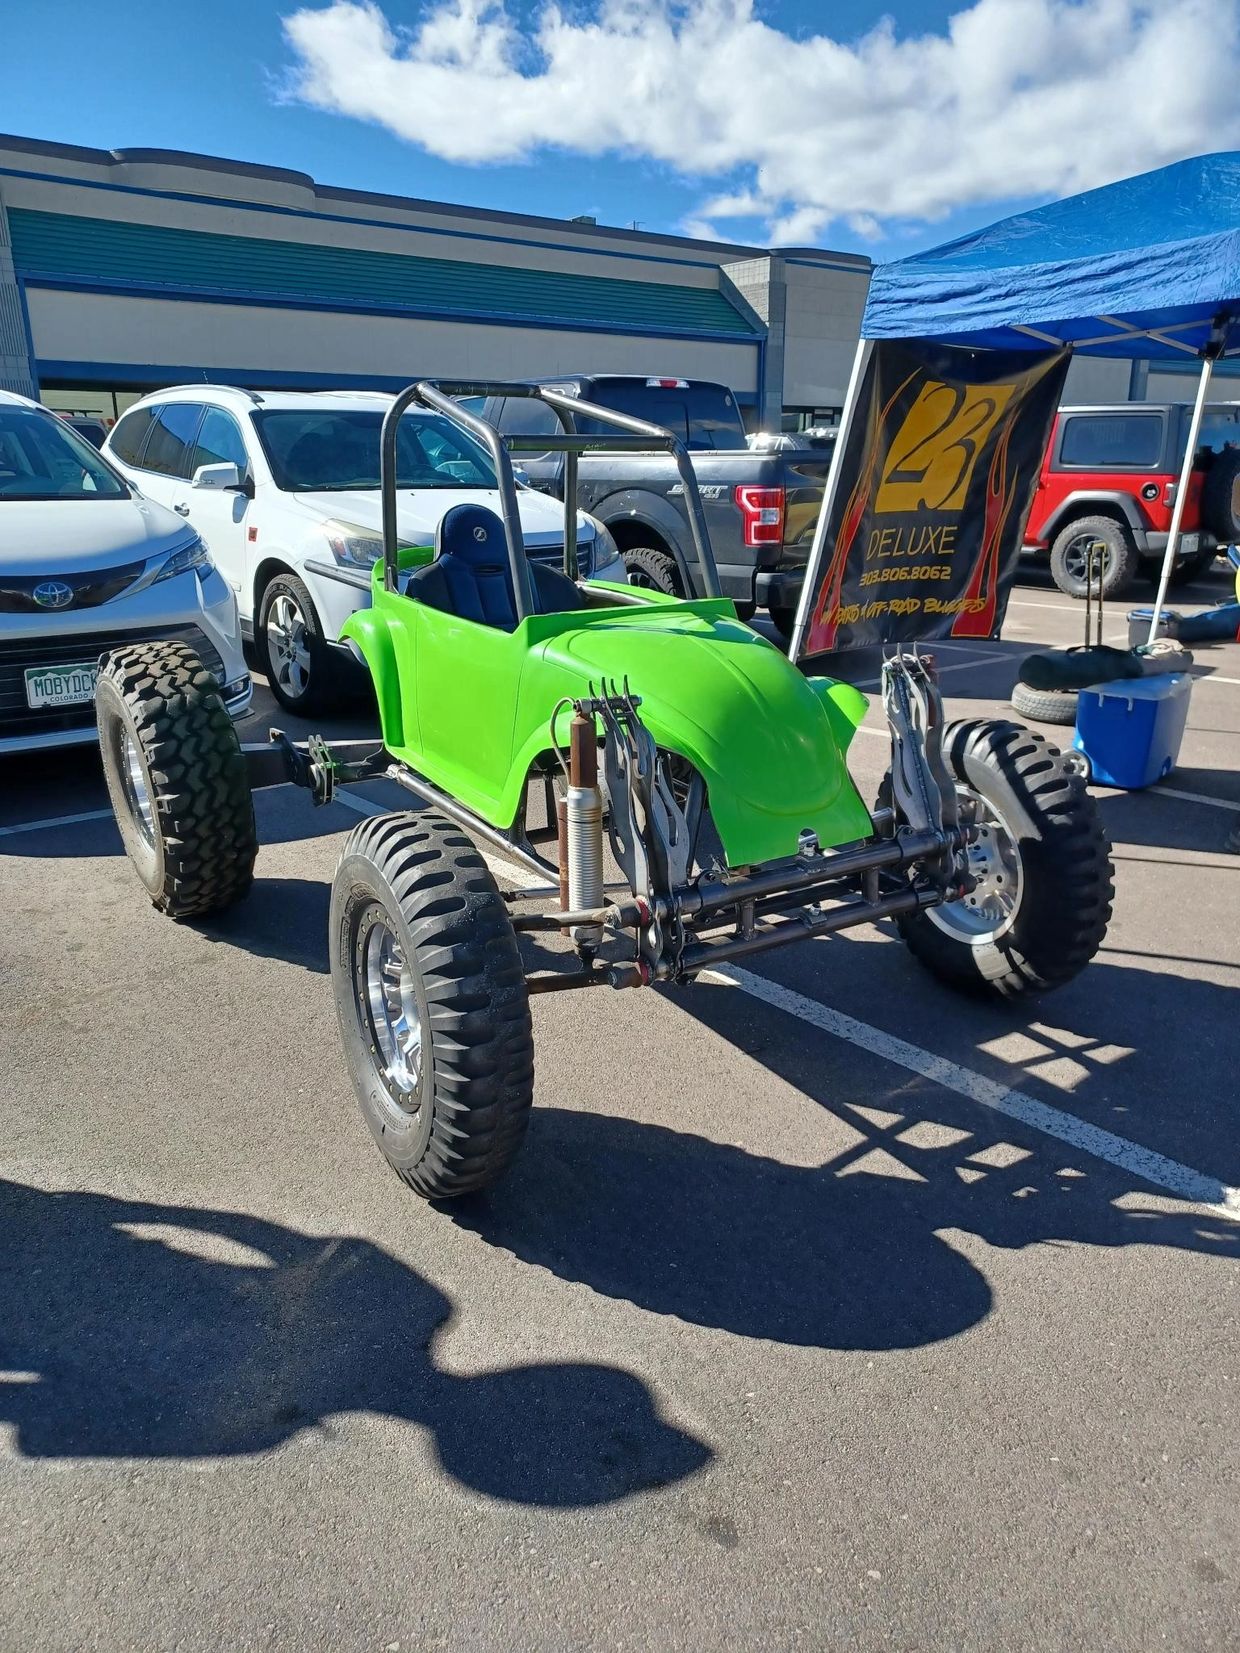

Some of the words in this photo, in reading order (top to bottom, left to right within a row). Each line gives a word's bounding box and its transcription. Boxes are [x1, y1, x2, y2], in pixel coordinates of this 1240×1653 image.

[866, 526, 958, 561] DELUXE
[859, 566, 952, 587] 303.806.8062
[50, 693, 89, 702] COLORADO
